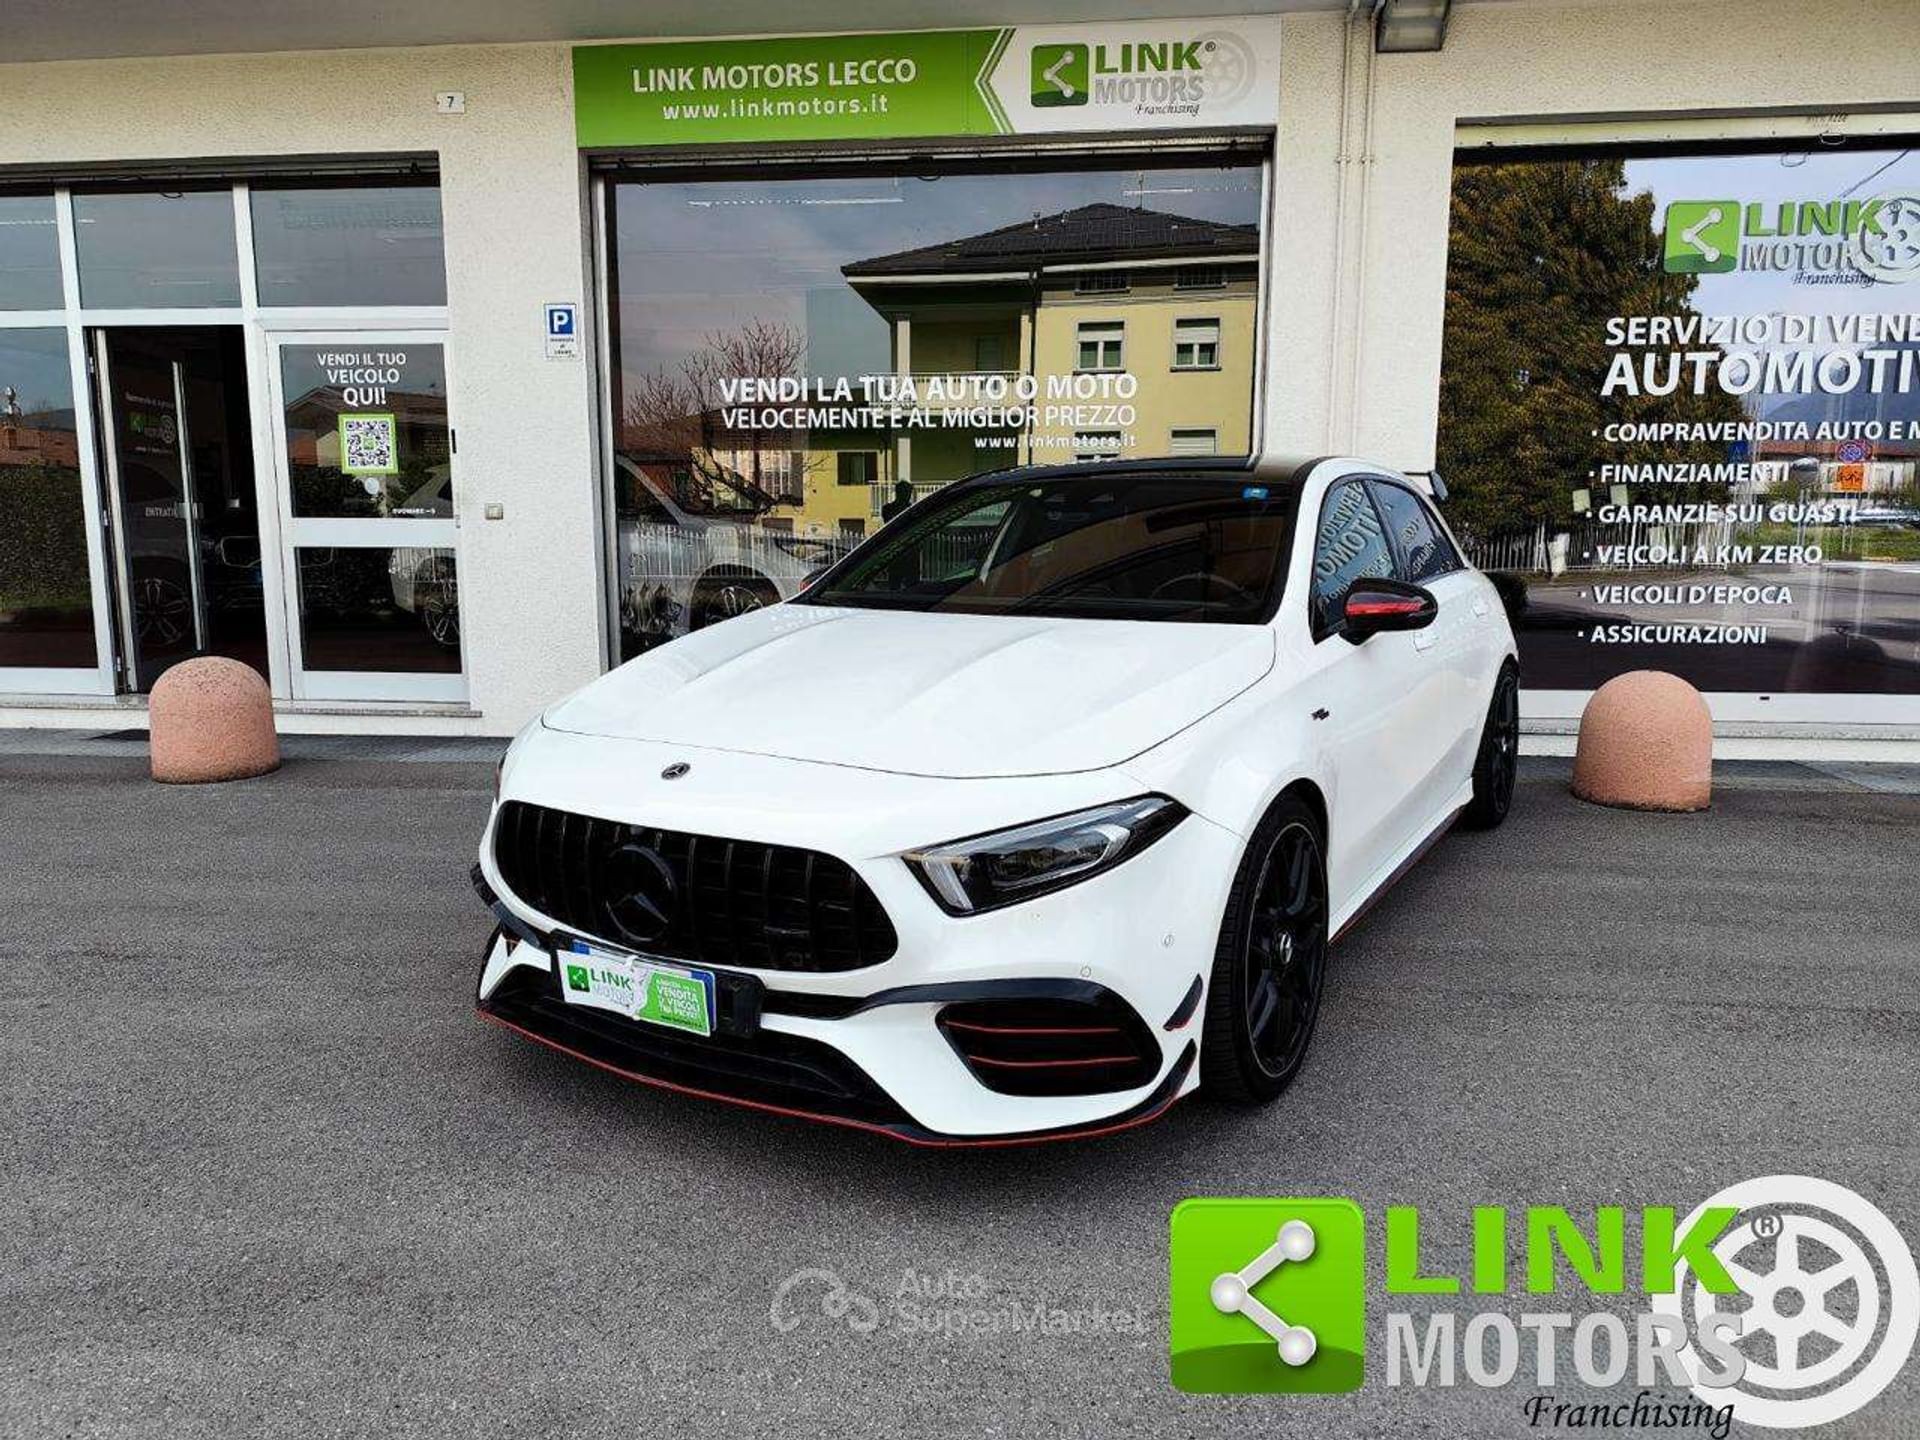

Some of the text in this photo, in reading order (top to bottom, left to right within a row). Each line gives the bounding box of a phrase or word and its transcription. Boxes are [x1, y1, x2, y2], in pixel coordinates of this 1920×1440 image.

[1095, 41, 1203, 74] LINK
[633, 58, 917, 93] LINK MOTORS LECCO
[1094, 74, 1205, 105] MOTORS
[446, 95, 455, 108] 7
[662, 93, 889, 121] www.linkmotors.it
[1133, 102, 1201, 117] Franchising
[1745, 199, 1886, 238] LINK
[553, 311, 569, 332] P
[1605, 315, 1773, 346] SERVIZIO
[1780, 314, 1820, 343] DI
[317, 352, 407, 366] VENDI IL TUO
[327, 368, 400, 383] VEICOLO
[1600, 351, 1920, 396] AUTOMOTI
[343, 387, 387, 407] QUI!
[719, 373, 1138, 402] VENDI LA TUA AUTO O MOTO
[721, 405, 1136, 430] VELOCEMENTE E AL MIGLIOR PREZZO
[1604, 421, 1810, 442] COMPRAVENDITA
[1815, 421, 1883, 441] AUTO
[1888, 421, 1902, 440] E
[1600, 463, 1790, 483] FINANZIAMENTI
[1598, 500, 1857, 524] GARANZIE SUI GUASTI
[1597, 545, 1823, 564] VEICOLI A KM ZERO
[1593, 586, 1683, 604] VEICOLI
[1590, 625, 1767, 644] ASSICURAZIONI
[590, 967, 632, 991] LINK
